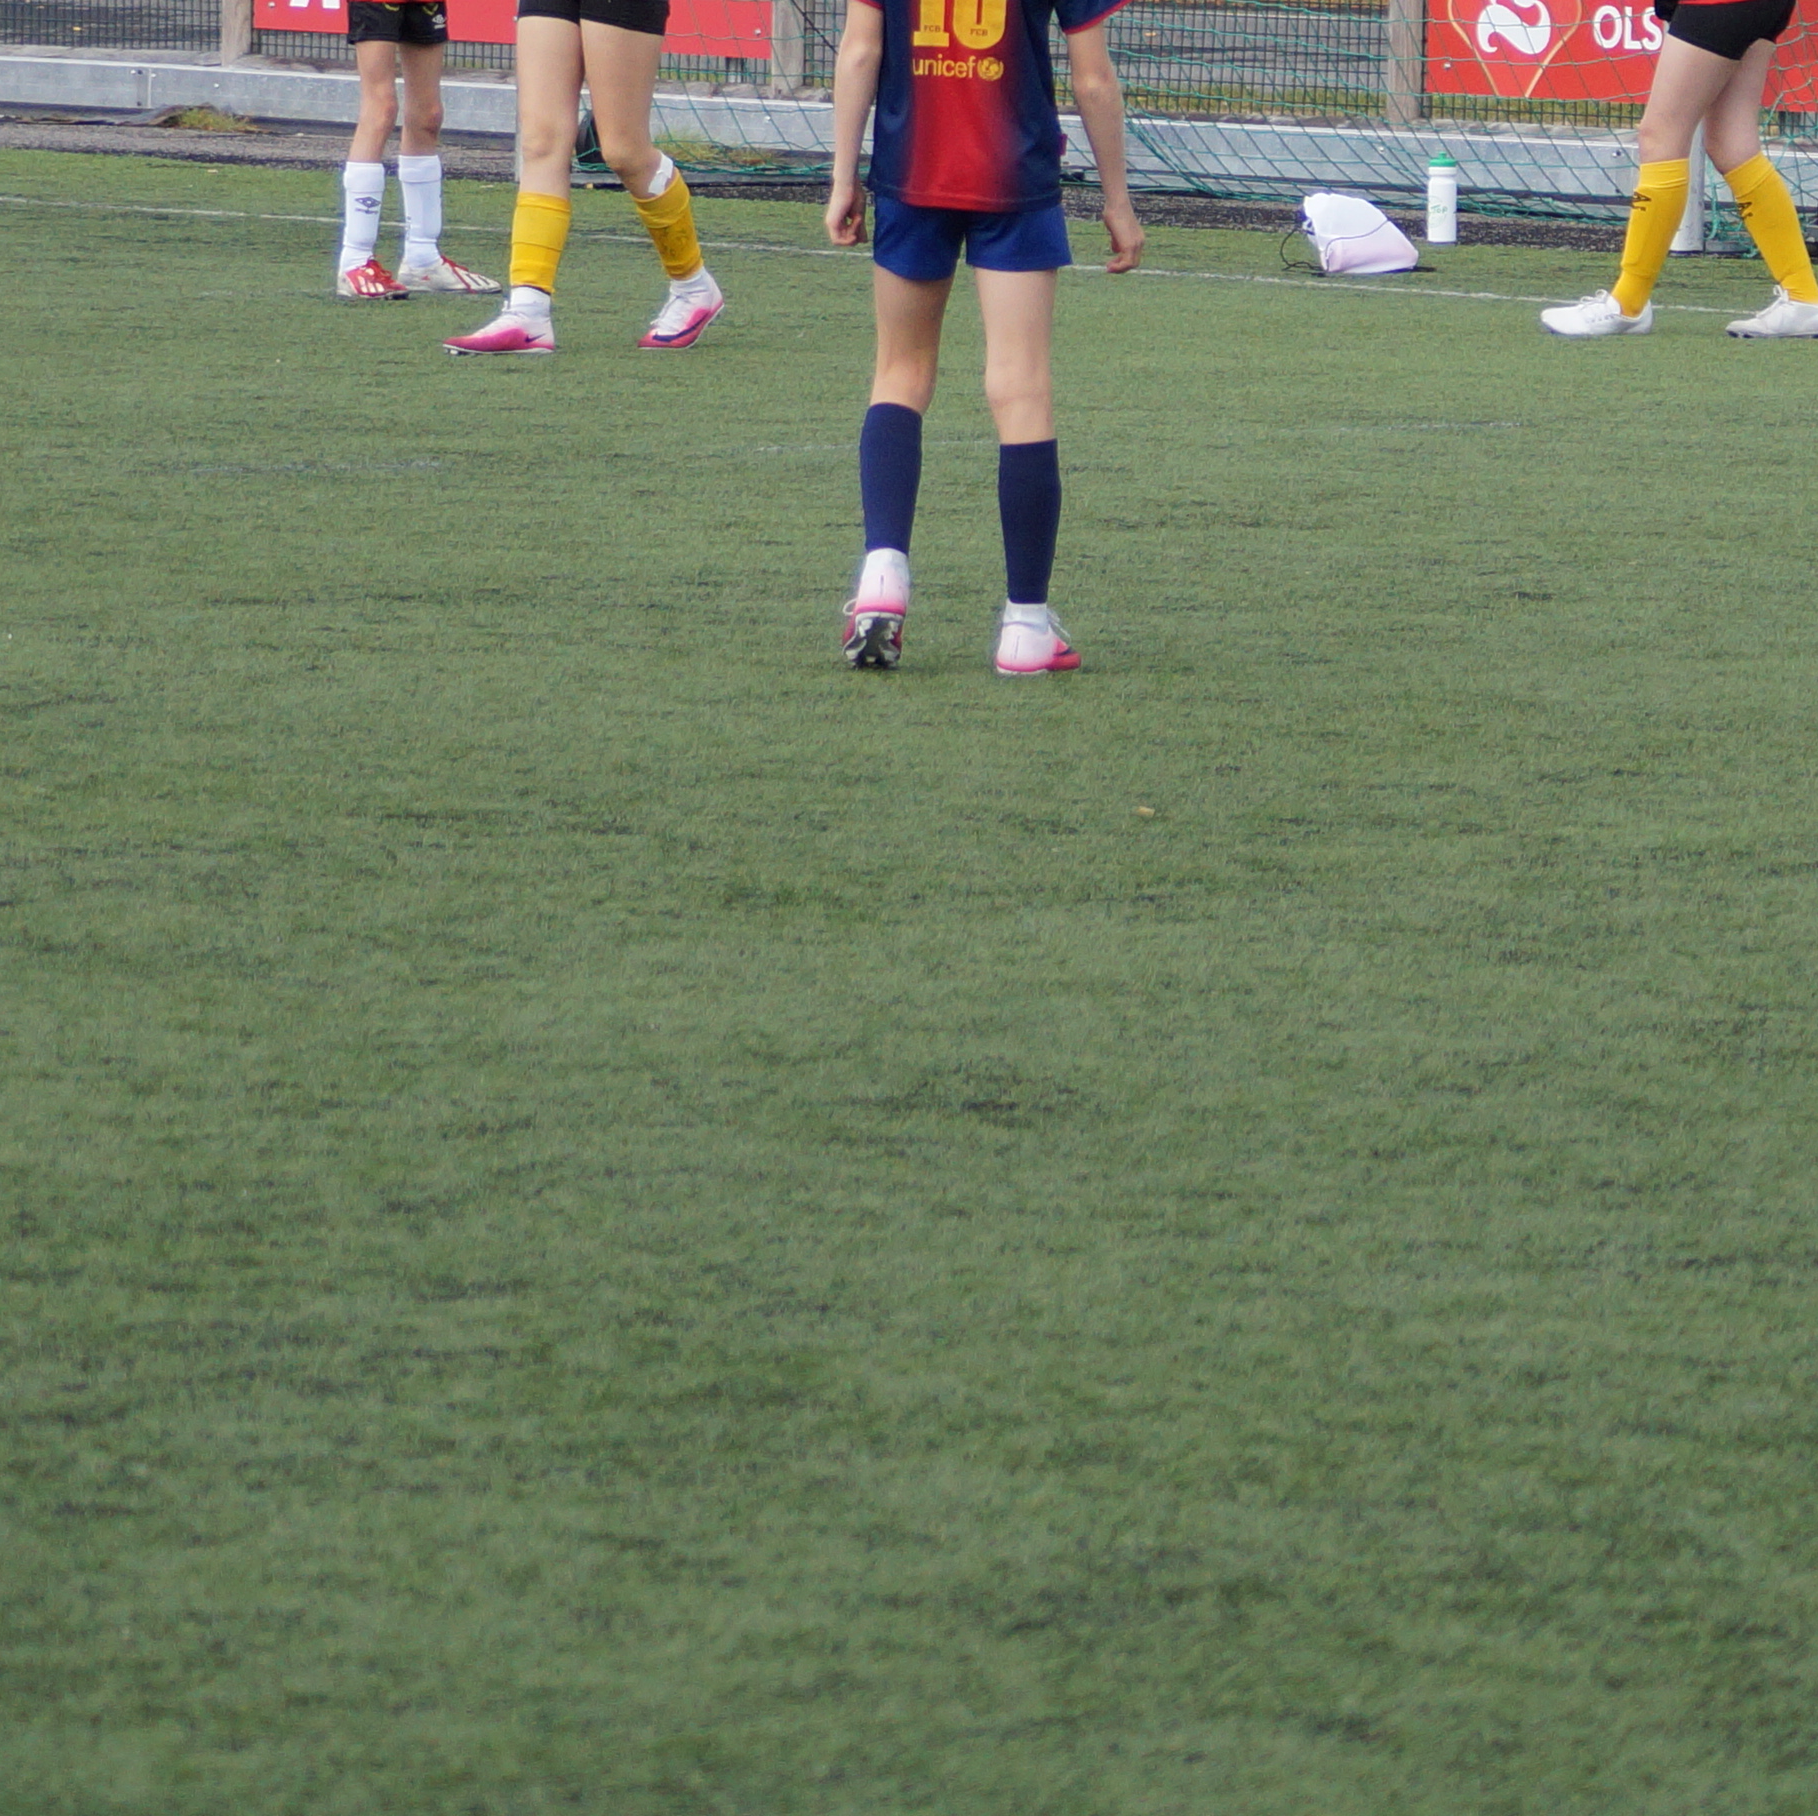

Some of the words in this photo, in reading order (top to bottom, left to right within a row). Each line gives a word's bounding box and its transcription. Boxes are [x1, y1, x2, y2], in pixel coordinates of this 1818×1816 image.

[924, 24, 941, 33] FCB
[970, 28, 988, 37] FCB
[1593, 5, 1662, 51] OLS
[912, 53, 977, 78] unicef
